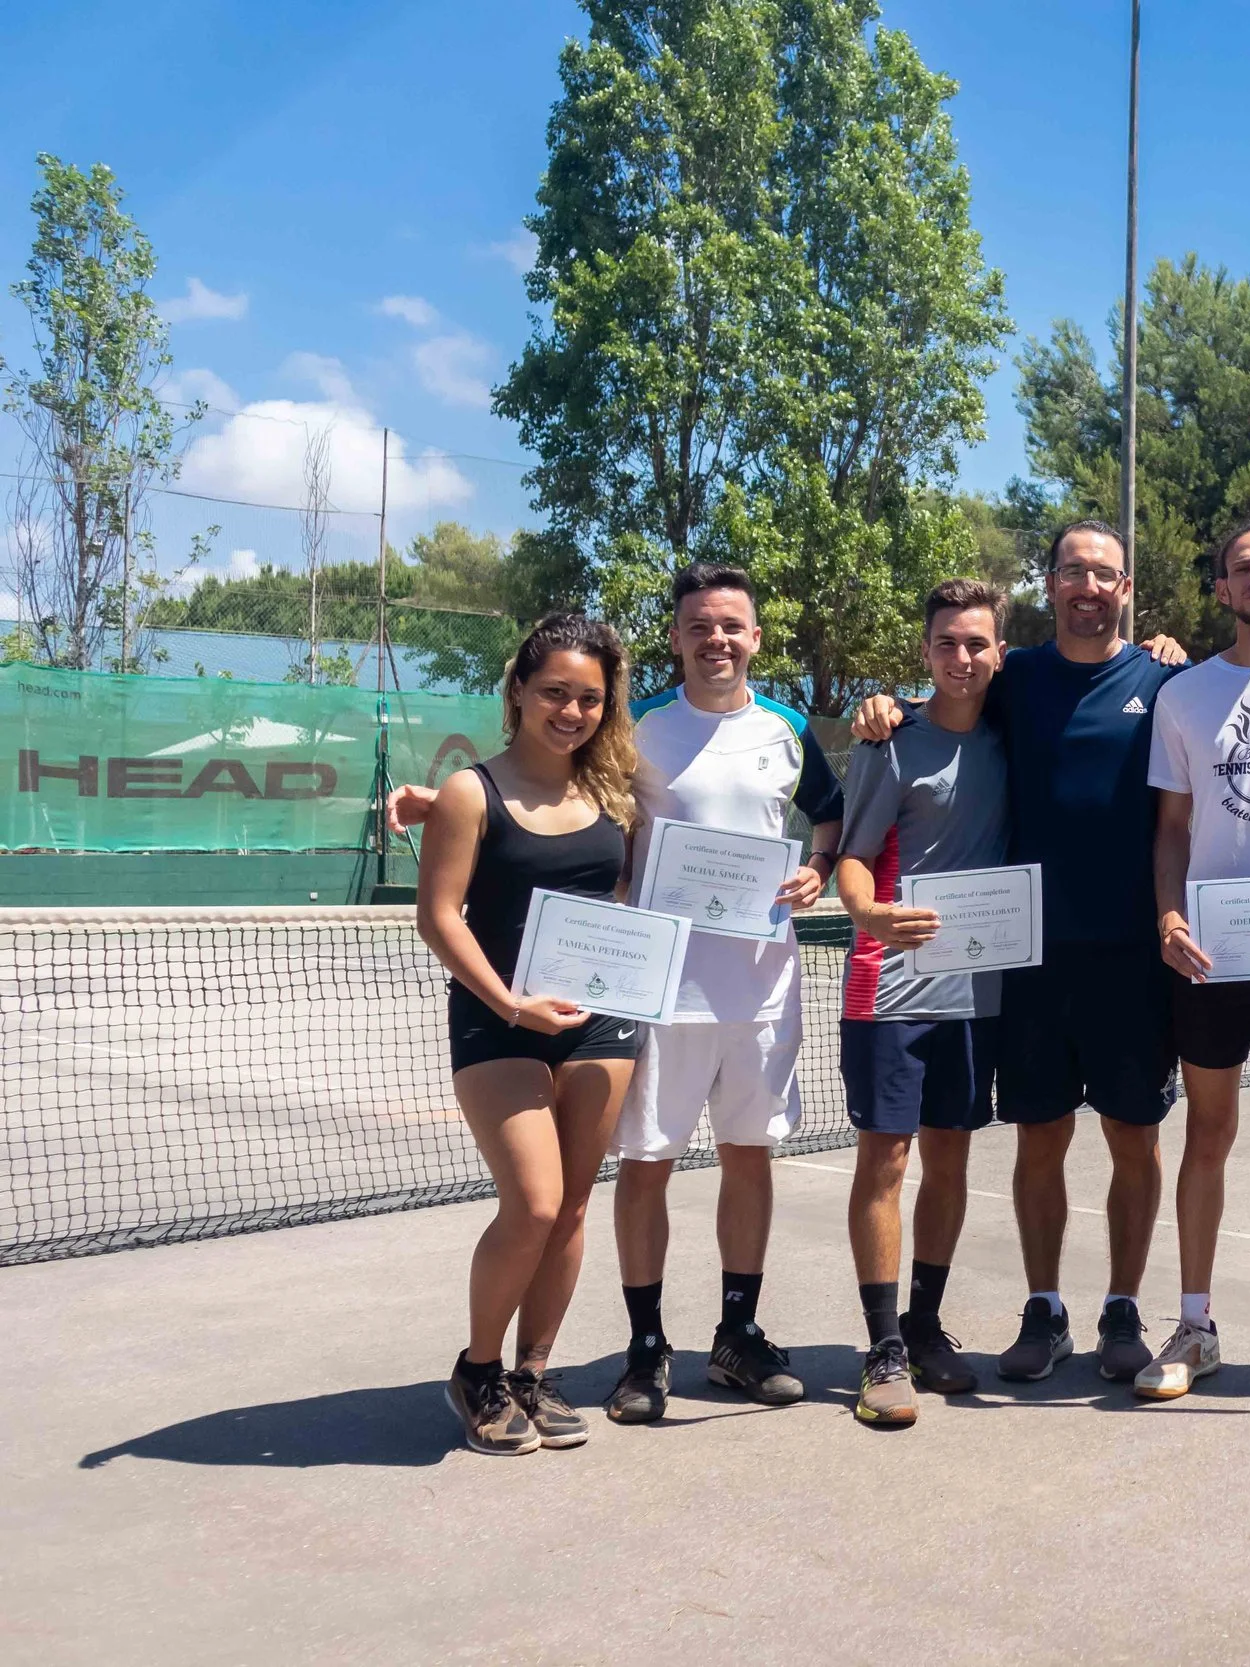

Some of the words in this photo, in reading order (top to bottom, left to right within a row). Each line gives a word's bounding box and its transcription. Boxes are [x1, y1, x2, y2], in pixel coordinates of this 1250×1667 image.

[17, 680, 81, 700] head.com
[18, 748, 338, 800] HEAD
[684, 843, 718, 855] Certificate
[727, 850, 765, 862] Completion
[681, 864, 717, 877] MICHAL
[935, 892, 967, 901] Certificate
[975, 888, 1011, 897] Completion
[991, 907, 1021, 916] LOBATO
[564, 916, 600, 931] Certificate
[602, 923, 611, 932] of
[610, 925, 652, 940] Completion
[556, 937, 597, 953] TAMEKA
[598, 944, 648, 962] PETERSON
